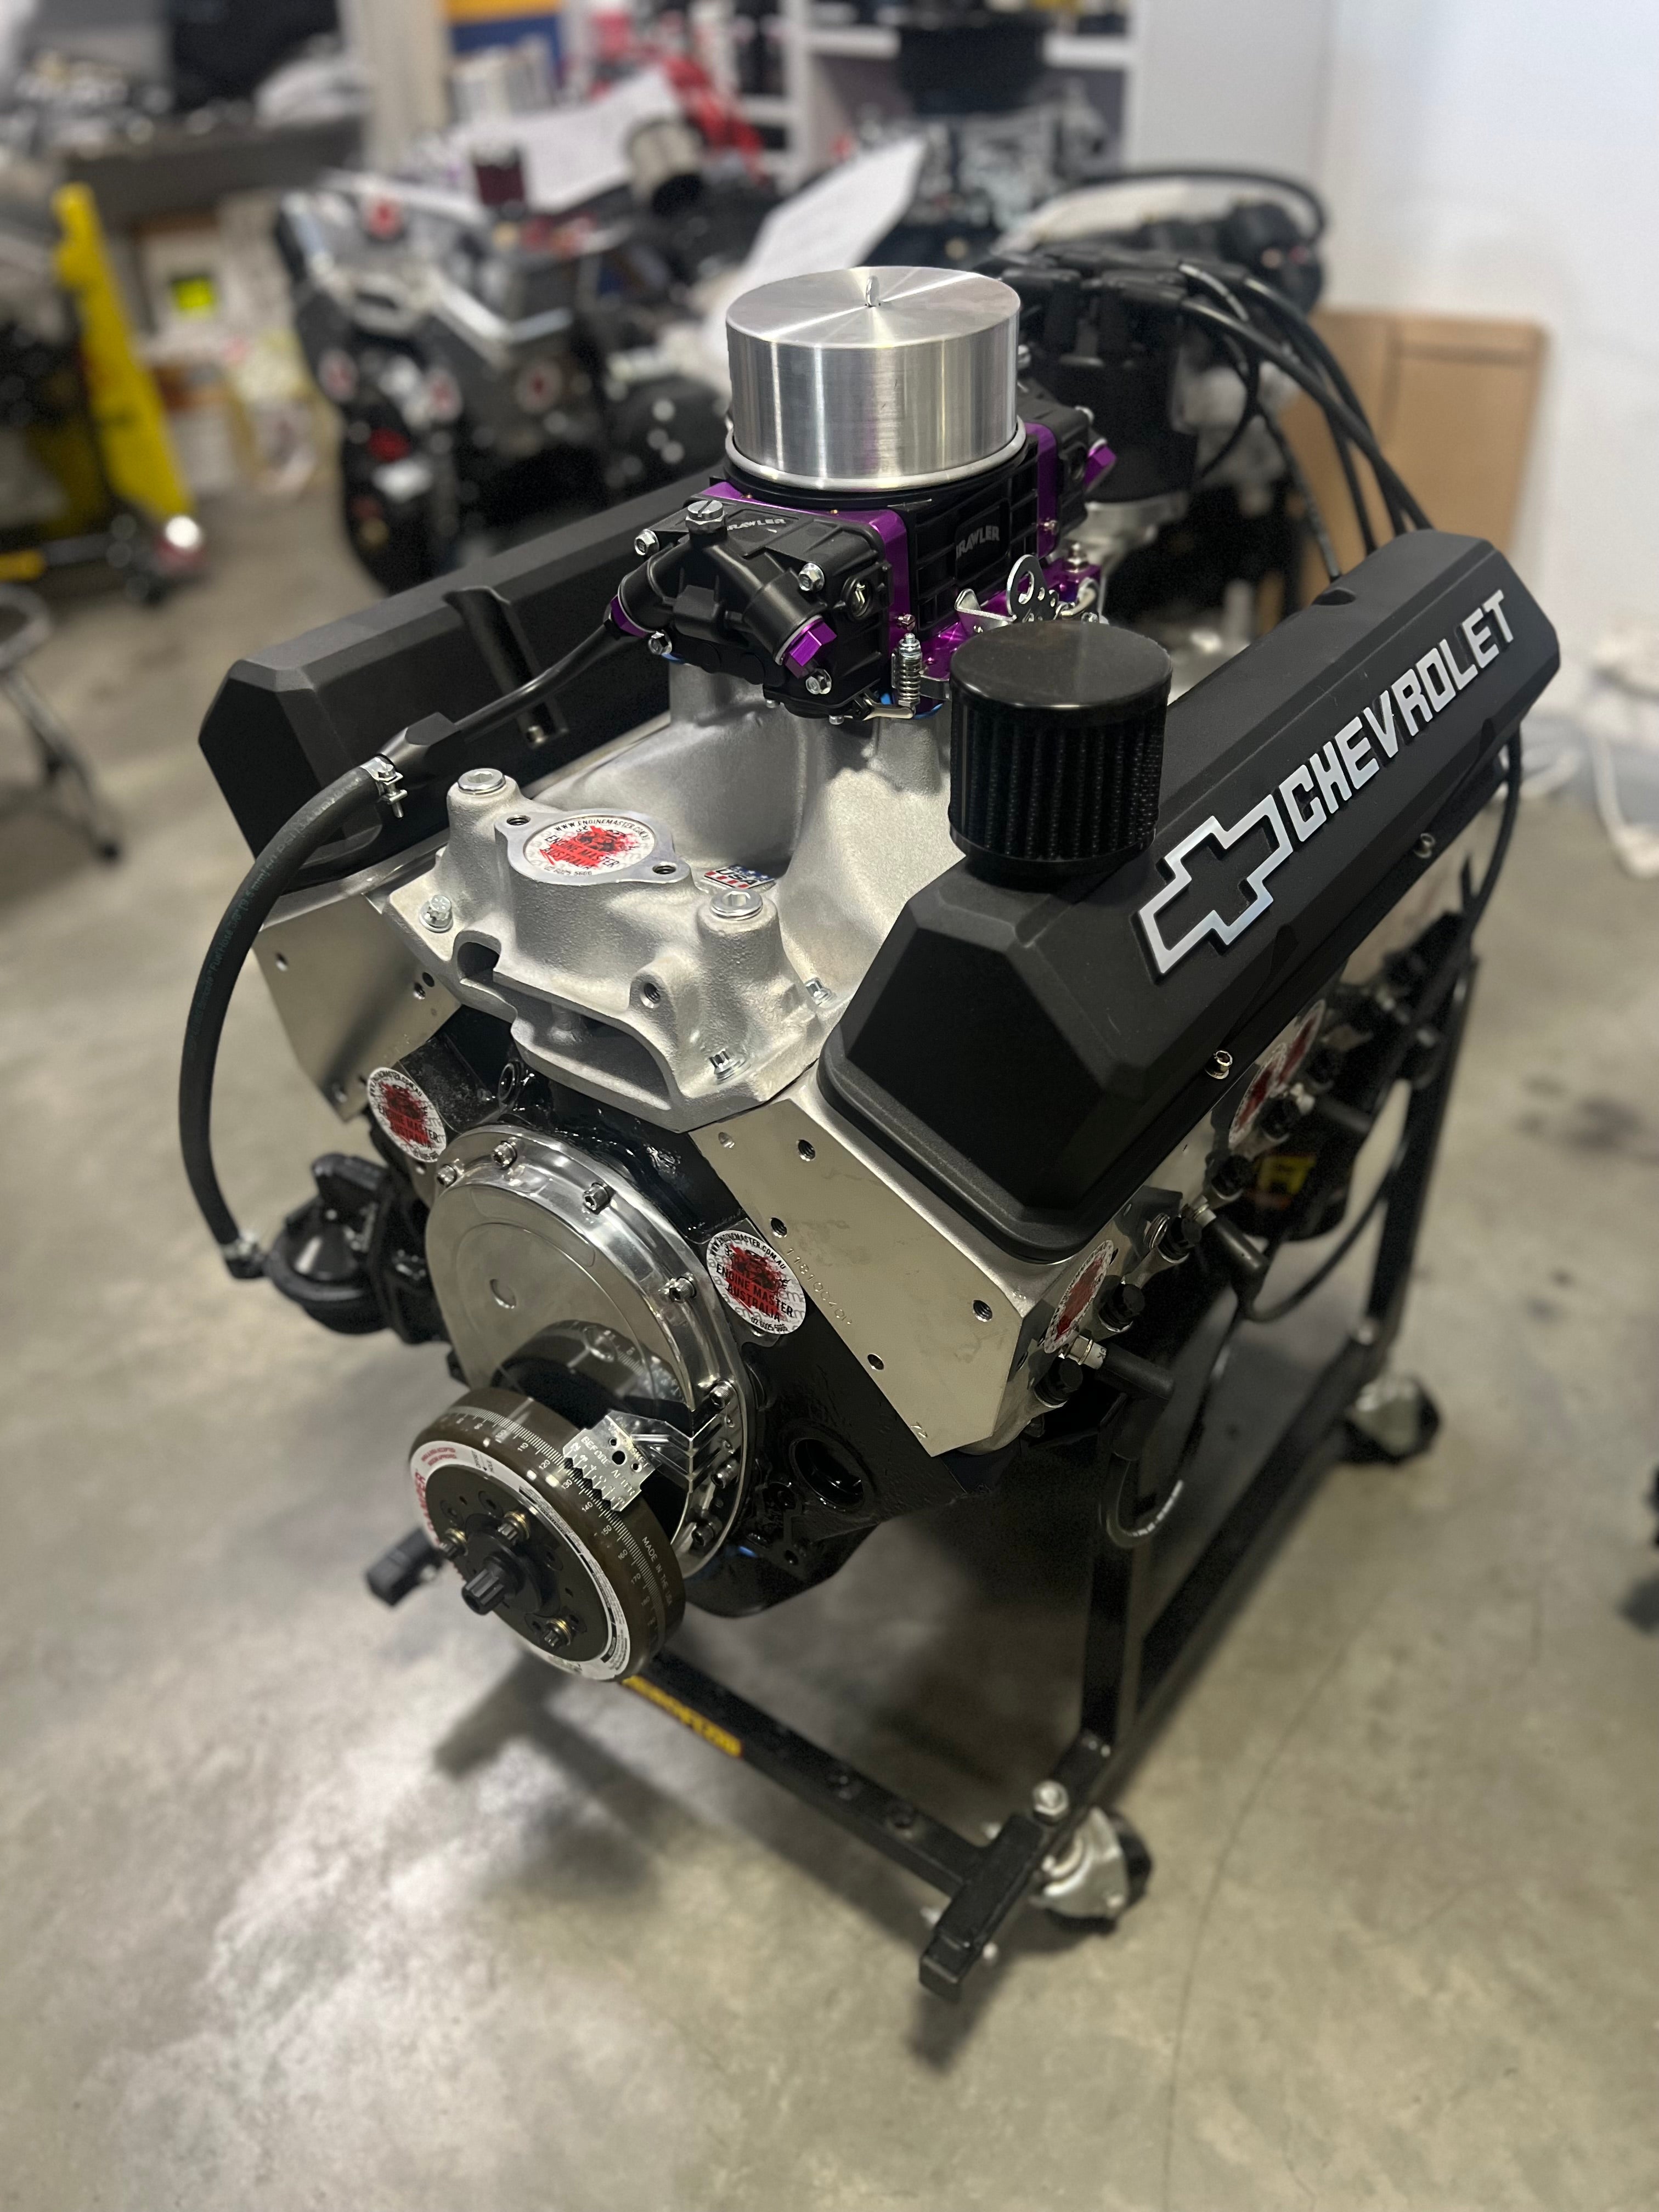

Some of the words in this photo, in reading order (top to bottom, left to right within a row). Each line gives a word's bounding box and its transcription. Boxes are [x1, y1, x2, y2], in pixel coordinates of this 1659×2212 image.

[727, 518, 786, 531] RAWLER
[1279, 590, 1514, 842] CHEVROLET
[545, 834, 584, 854] ENGINE
[581, 849, 620, 868] MASTER
[715, 869, 758, 885] USA
[716, 1263, 751, 1291] ENGINE
[753, 1283, 794, 1318] MASTER
[727, 1284, 781, 1323] AUSTRALIA
[517, 1442, 529, 1453] 110
[538, 1459, 551, 1470] 120
[561, 1479, 573, 1490] 130
[582, 1501, 593, 1513] 140
[601, 1524, 612, 1536] 150
[618, 1549, 628, 1560] 160
[642, 1536, 658, 1562] MADE
[655, 1563, 663, 1573] IN
[660, 1573, 669, 1590] THE
[630, 1572, 641, 1585] 170
